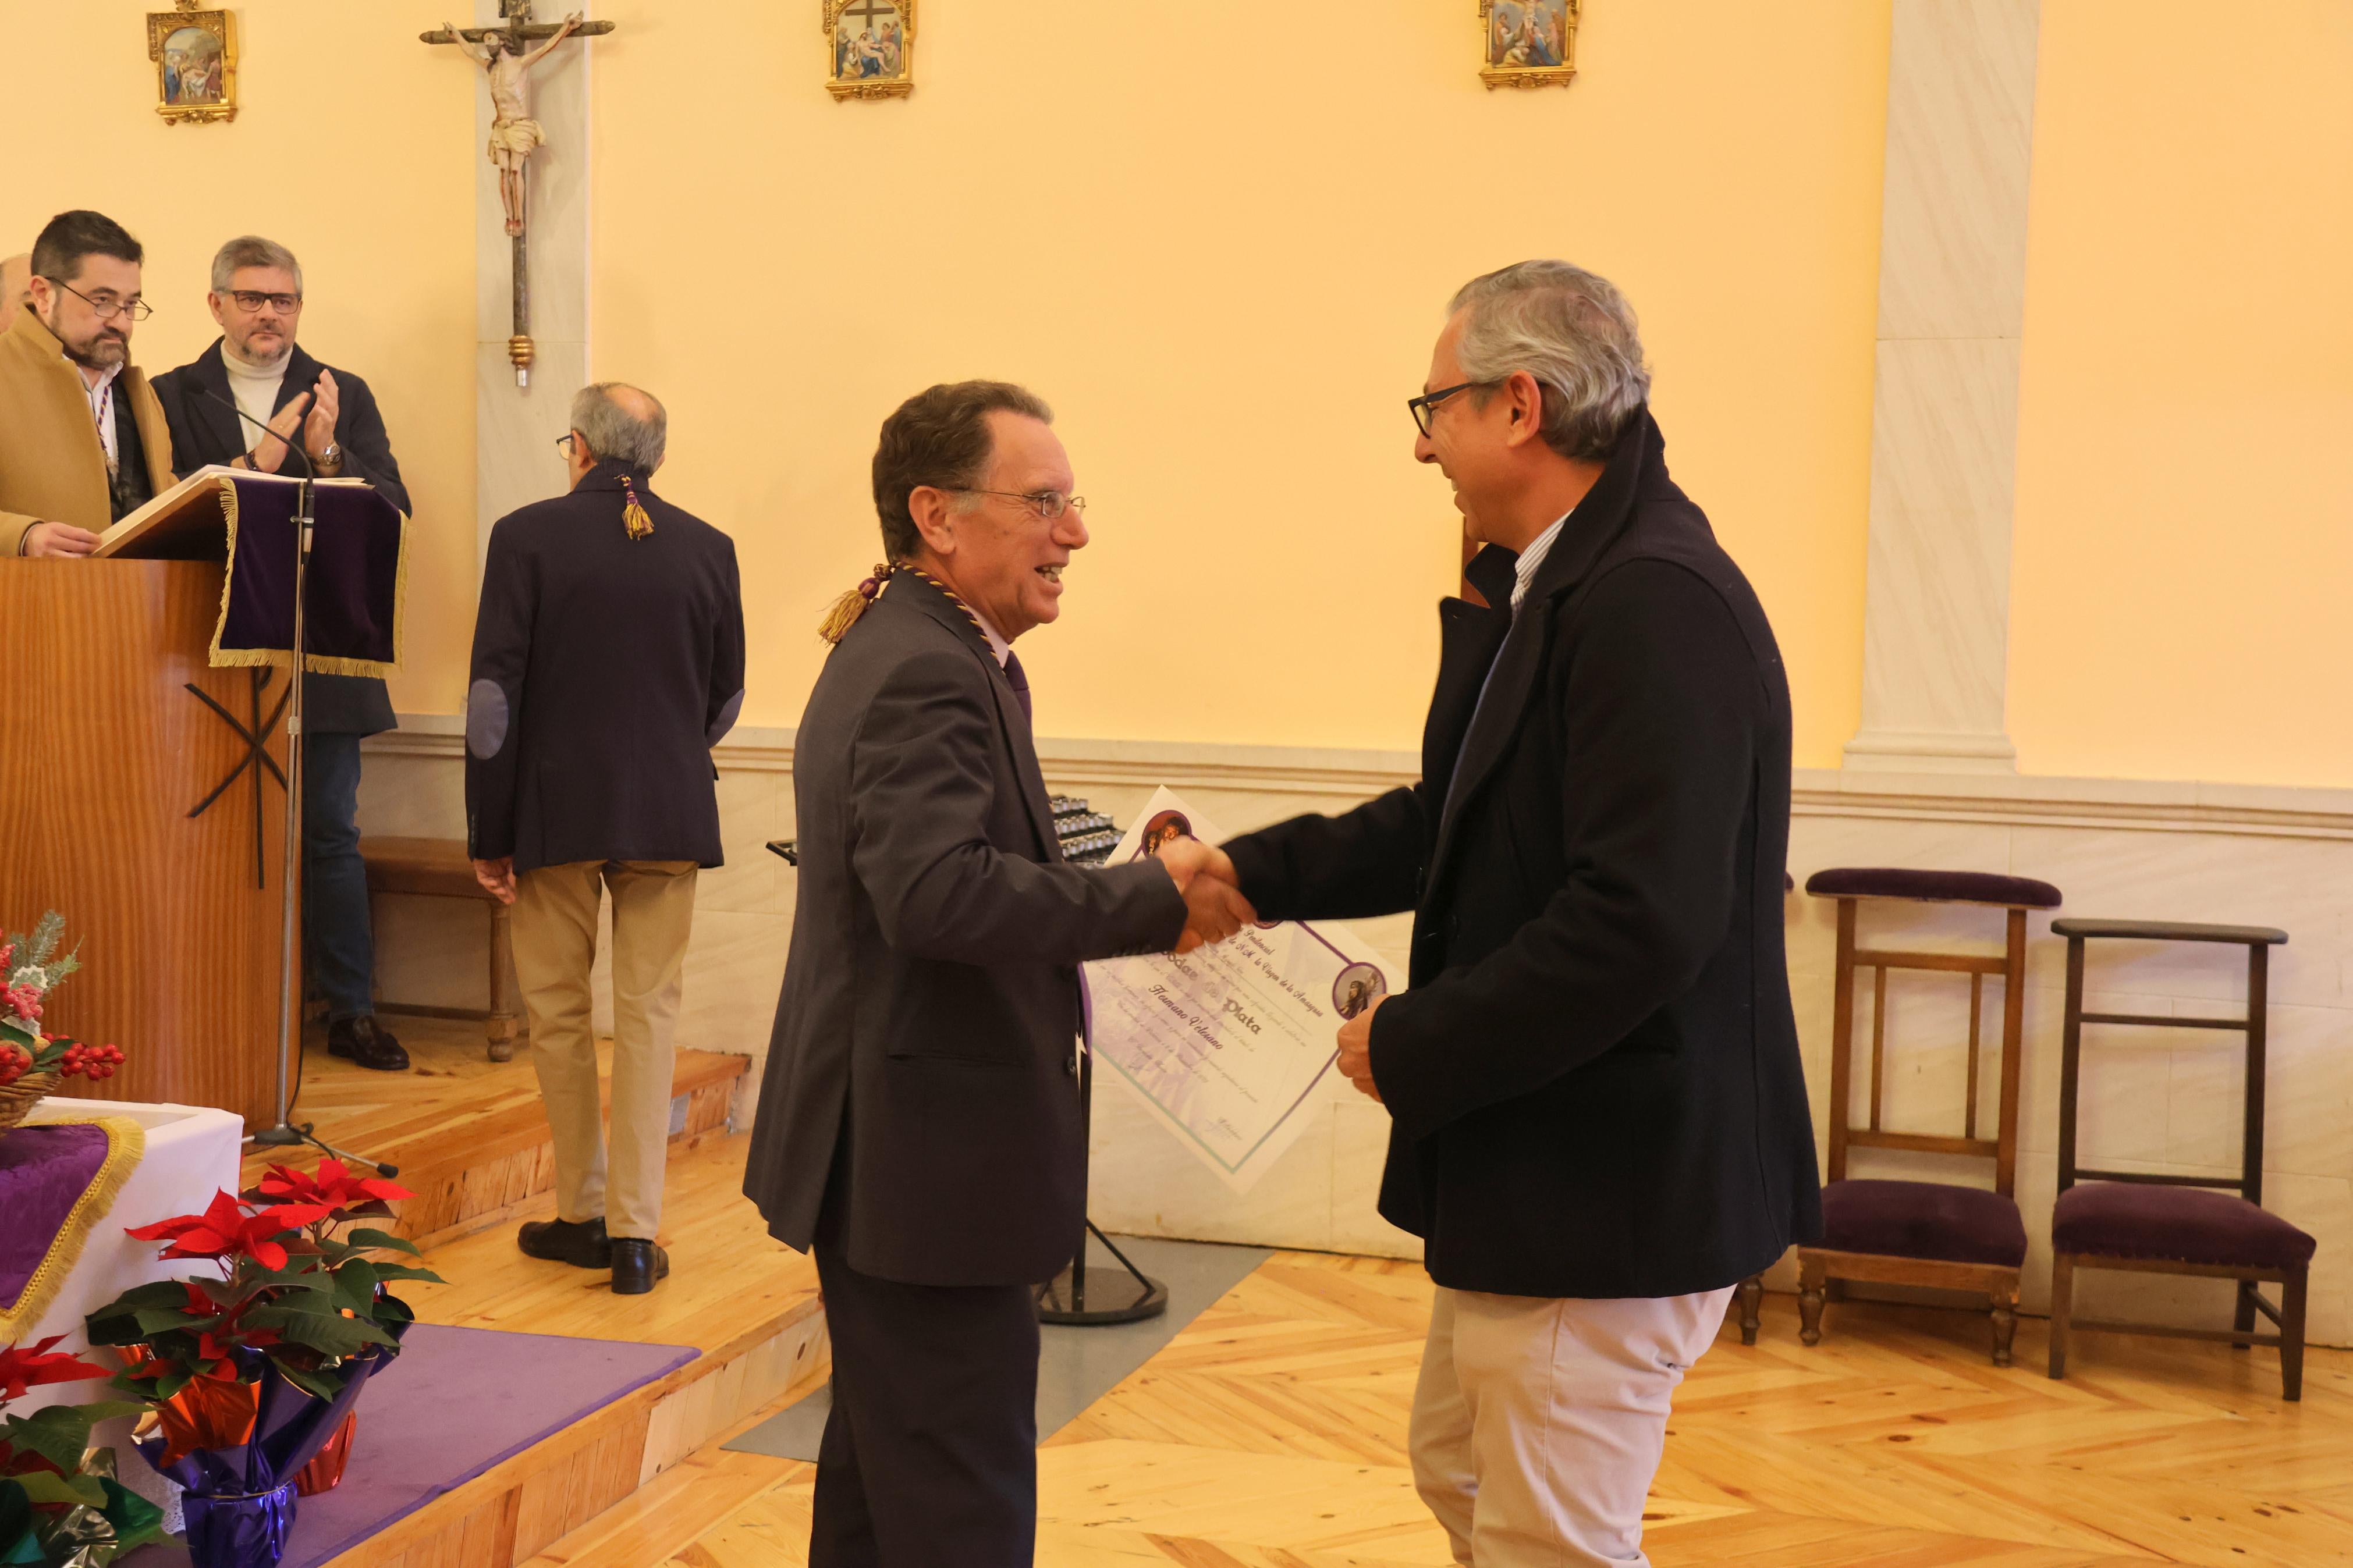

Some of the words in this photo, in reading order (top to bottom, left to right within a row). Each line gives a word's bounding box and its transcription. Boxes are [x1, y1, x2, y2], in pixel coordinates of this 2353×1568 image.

[1243, 929, 1276, 955] Penitencial
[1227, 936, 1237, 945] de
[1253, 957, 1262, 966] la
[1261, 961, 1280, 982] Virgen
[1278, 979, 1289, 988] de
[1285, 983, 1294, 993] la
[1292, 990, 1323, 1018] Amargura
[1147, 983, 1188, 1019] Hermano
[1188, 1016, 1223, 1050] Veterano
[1222, 997, 1262, 1035] Plata
